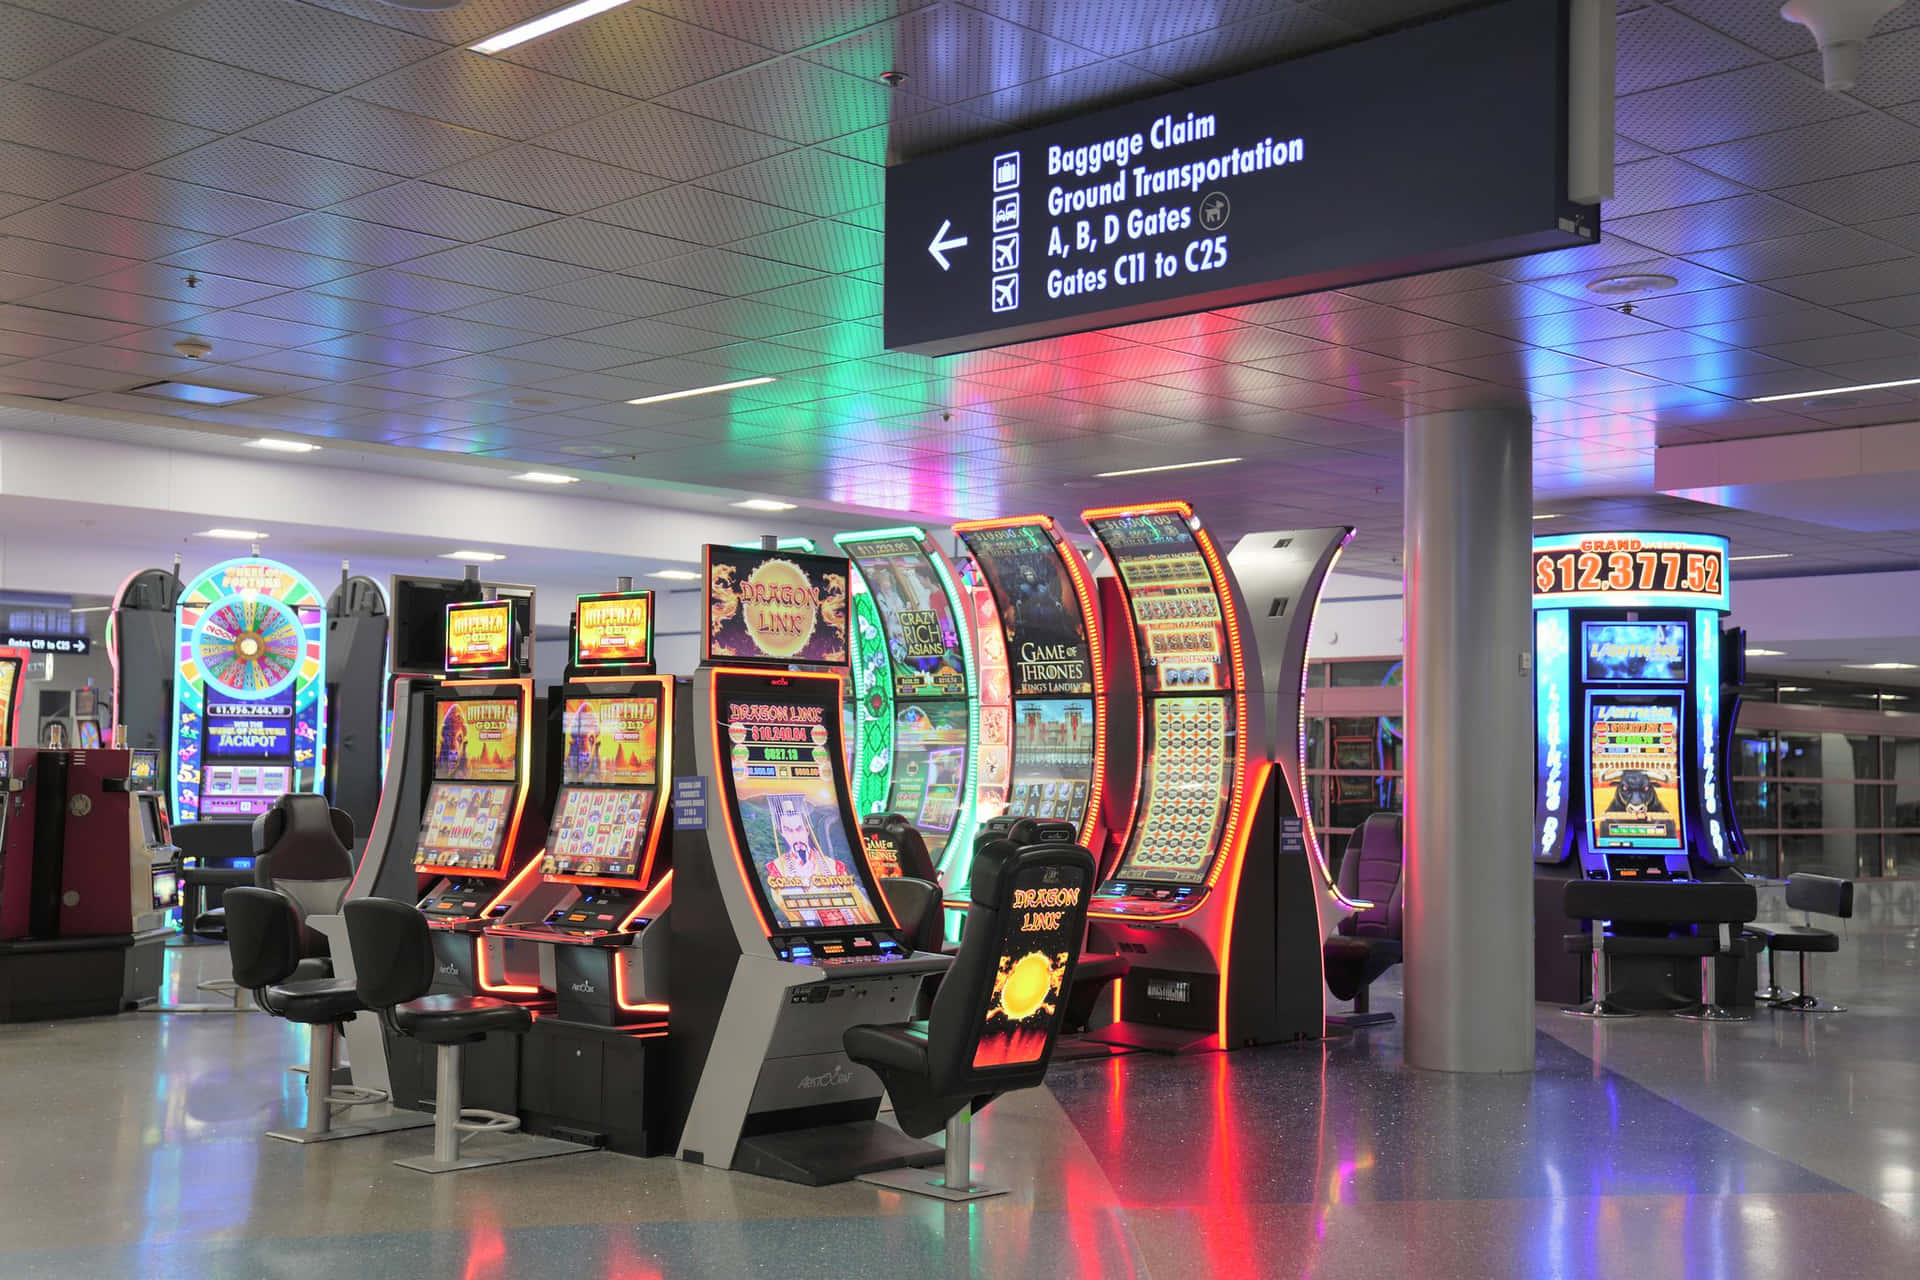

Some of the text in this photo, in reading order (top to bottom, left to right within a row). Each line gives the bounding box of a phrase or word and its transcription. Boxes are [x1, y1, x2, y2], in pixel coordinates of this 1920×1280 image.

[1047, 112, 1216, 176] Baggage Claim
[1047, 136, 1304, 216] Ground Transportation
[1047, 203, 1192, 258] A, B, D Gates
[1047, 236, 1228, 298] Gates C11 to C25
[1581, 539, 1642, 552] GRAND
[1536, 552, 1719, 592] $12,377.52
[739, 580, 819, 608] DRAGON
[758, 611, 803, 635] LINK
[900, 611, 935, 625] CRAZY
[8, 638, 31, 648] Gates
[47, 641, 56, 650] to
[904, 624, 942, 643] RICH
[908, 642, 944, 655] ASIANS
[1021, 642, 1078, 662] GAME OF
[1590, 643, 1679, 658] LIGHTNING
[1017, 660, 1084, 682] THRONES
[728, 703, 824, 722] DRAGON LINK
[219, 735, 277, 747] JACKPOT
[1012, 887, 1080, 909] DRAGON
[1021, 911, 1061, 932] LINK
